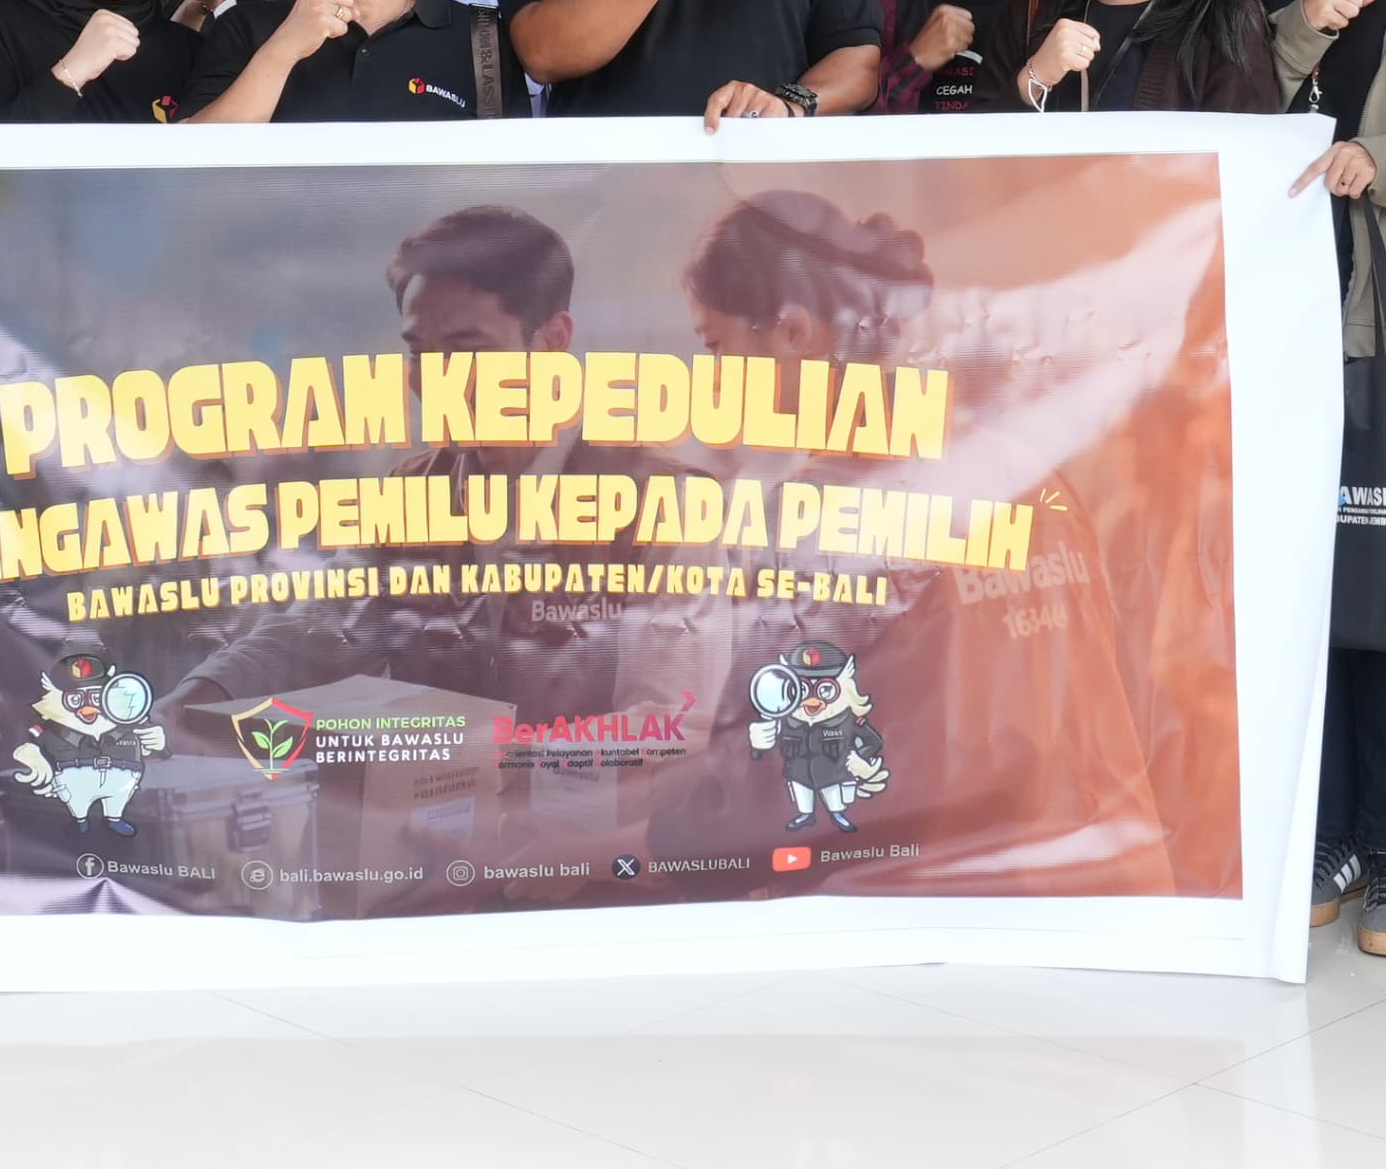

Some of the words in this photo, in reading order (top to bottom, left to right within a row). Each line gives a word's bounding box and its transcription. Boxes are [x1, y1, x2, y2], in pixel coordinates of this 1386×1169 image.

[426, 84, 466, 108] BAWASLU
[935, 84, 973, 96] CEGAH
[421, 351, 951, 461] KEPEDULIAN
[277, 474, 508, 551] PEMILU
[518, 474, 769, 547] KEPADA
[779, 481, 1035, 572] PEMILIH
[951, 540, 1091, 606] Bawaslu
[66, 579, 220, 622] BAWASLU
[230, 567, 379, 607] PROVINSI
[390, 565, 451, 596] DAN
[461, 563, 748, 597] KABUPATEN/KOTA
[756, 567, 888, 606] SE-BALI
[531, 598, 624, 624] Bawaslu
[316, 718, 372, 731] POHON
[376, 715, 466, 729] INTEGRITAS
[492, 714, 687, 745] BerAKHLAK
[315, 735, 375, 748] UNTUK
[381, 732, 464, 746] BAWASLU
[315, 748, 451, 764] BERINTEGRITAS
[820, 846, 885, 864] Bawaslu
[889, 843, 921, 859] Bali
[107, 860, 174, 877] Bawaslu
[178, 864, 216, 880] BALI
[279, 866, 424, 884] bali.bawaslu.go.id
[484, 863, 555, 880] bawaslu
[559, 862, 590, 879] bali
[648, 857, 751, 874] BAWASLUBALI
